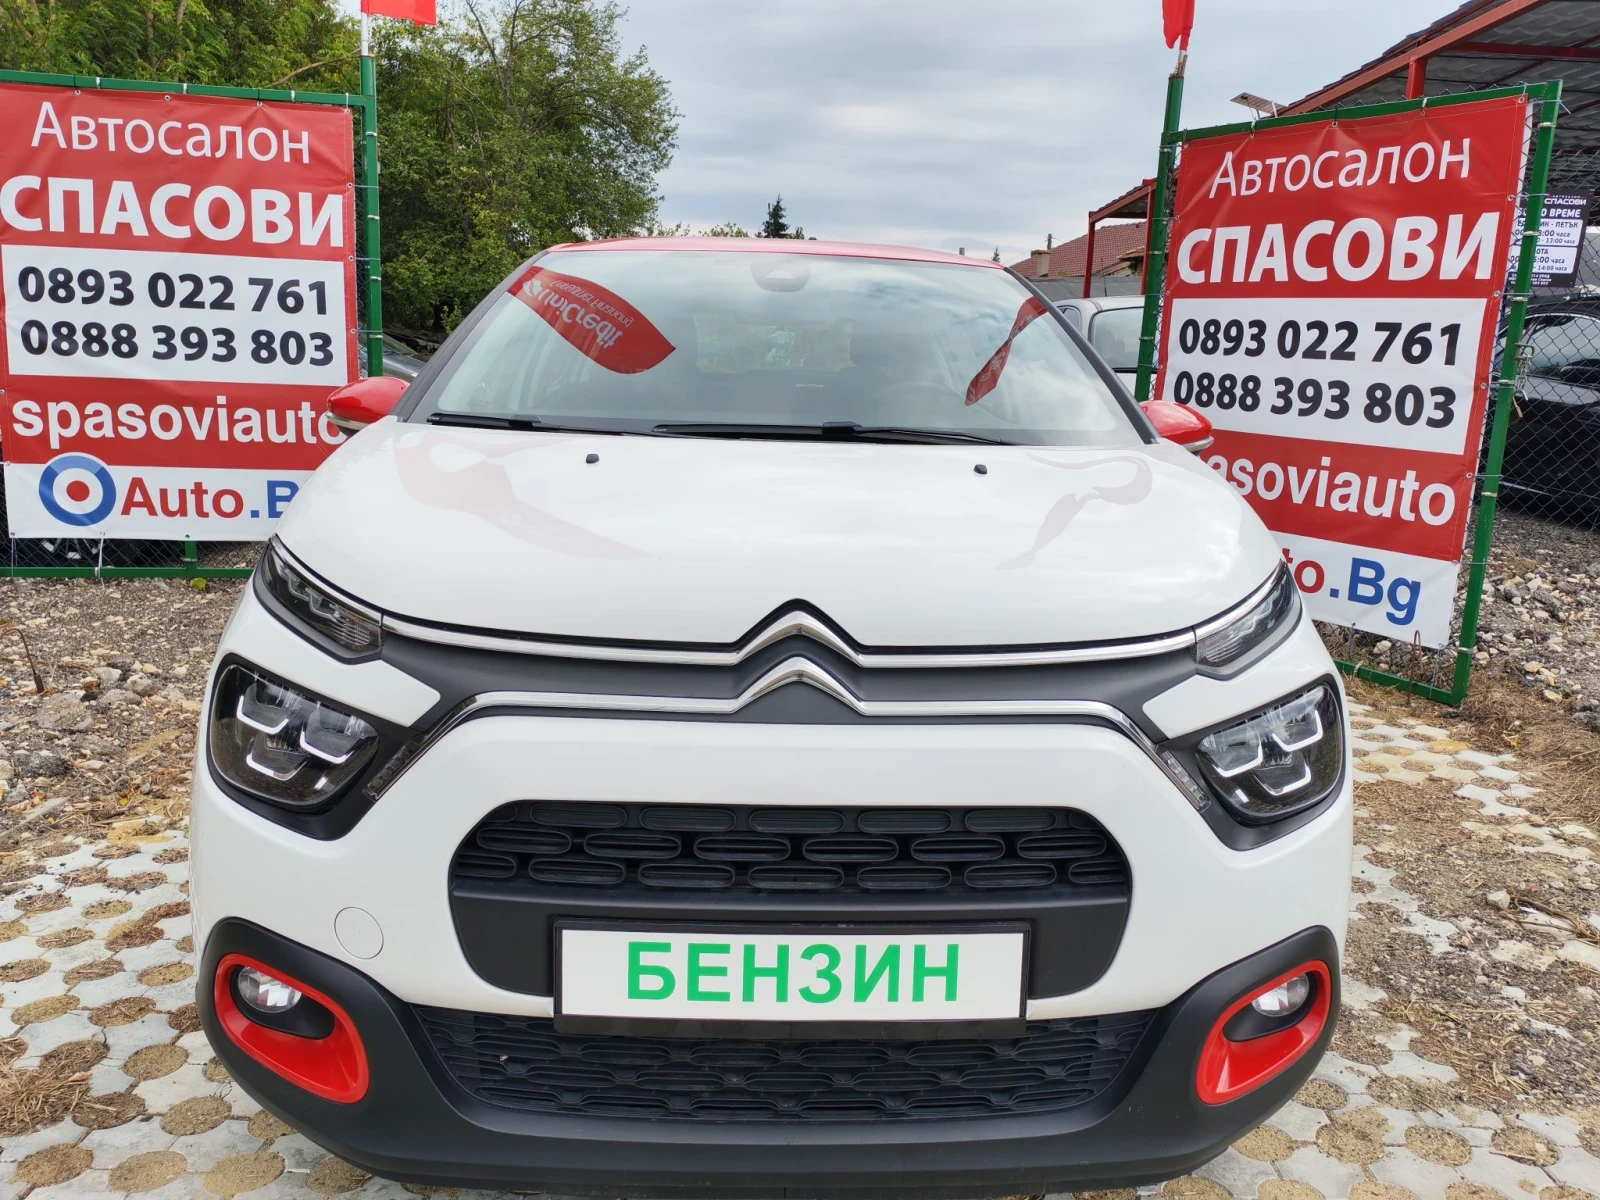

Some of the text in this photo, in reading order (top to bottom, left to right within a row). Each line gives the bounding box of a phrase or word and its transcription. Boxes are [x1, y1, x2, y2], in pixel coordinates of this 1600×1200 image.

[0, 175, 344, 248] СПАСОВИ
[1549, 208, 1581, 217] ВРЕМЕ
[1176, 211, 1500, 285] СПАСОВИ
[18, 266, 328, 316] 0893 022 761
[20, 319, 335, 367] 0888 393 803
[1178, 317, 1460, 366] 0893 022 761
[1174, 371, 1457, 429] 0888 393 803
[1207, 454, 1455, 526] asoviauto
[627, 941, 960, 1003] БЕНЗИН
